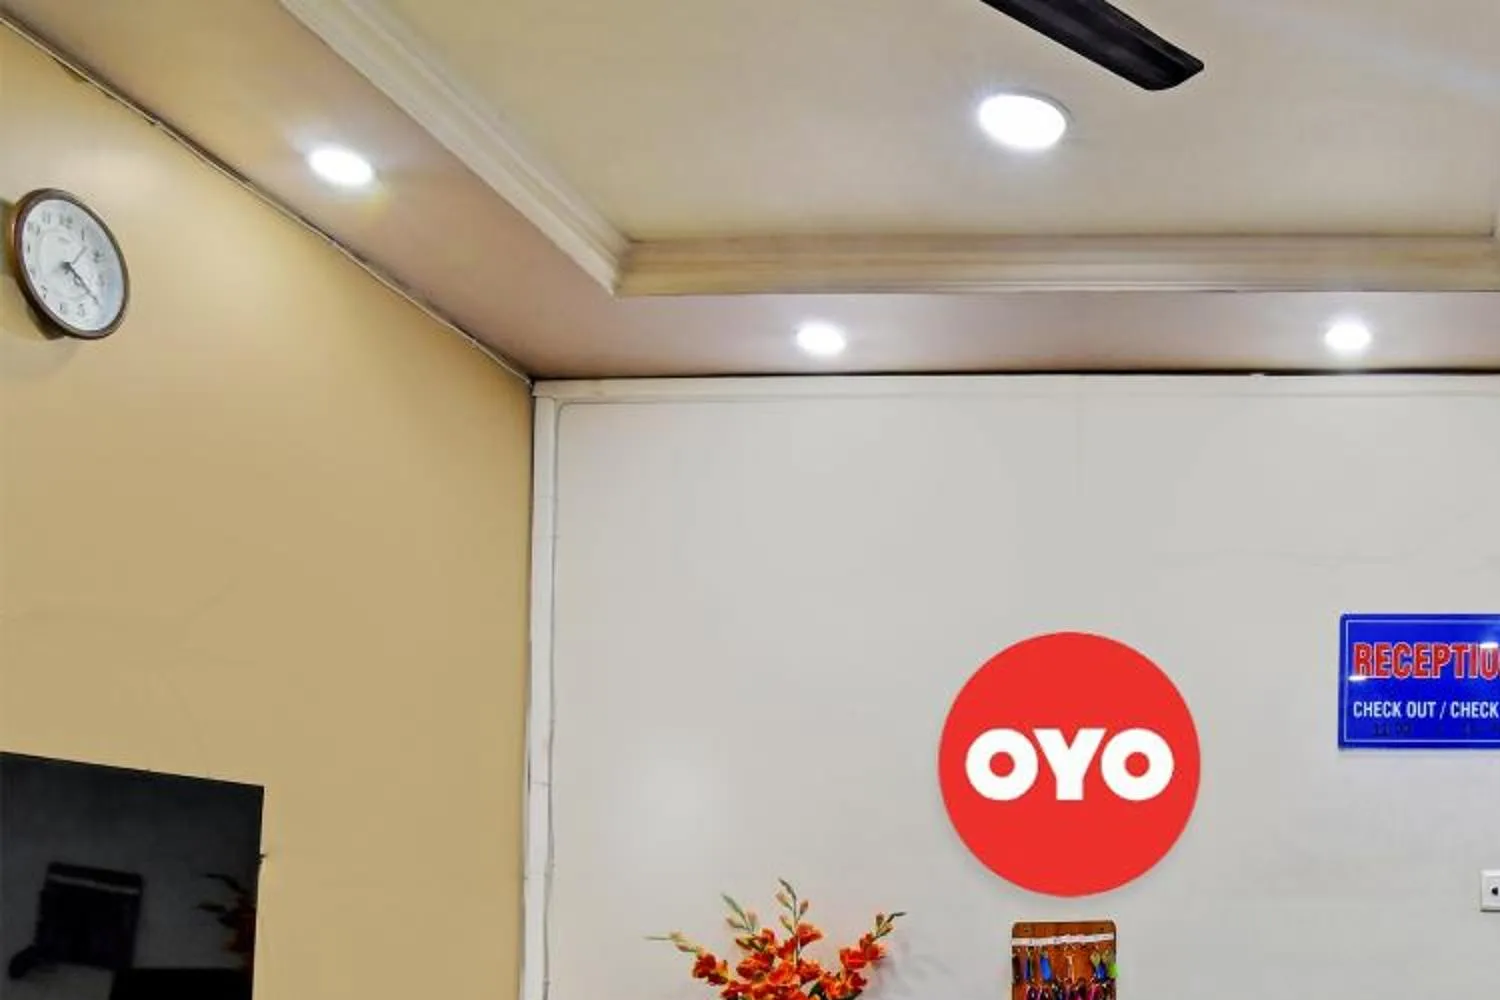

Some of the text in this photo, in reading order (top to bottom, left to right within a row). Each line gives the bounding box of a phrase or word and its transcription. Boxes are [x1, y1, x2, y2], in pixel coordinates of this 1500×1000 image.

[1353, 701, 1402, 719] CHECK
[1406, 701, 1437, 719] OUT
[1451, 701, 1499, 719] CHECK
[965, 727, 1175, 801] OYO
